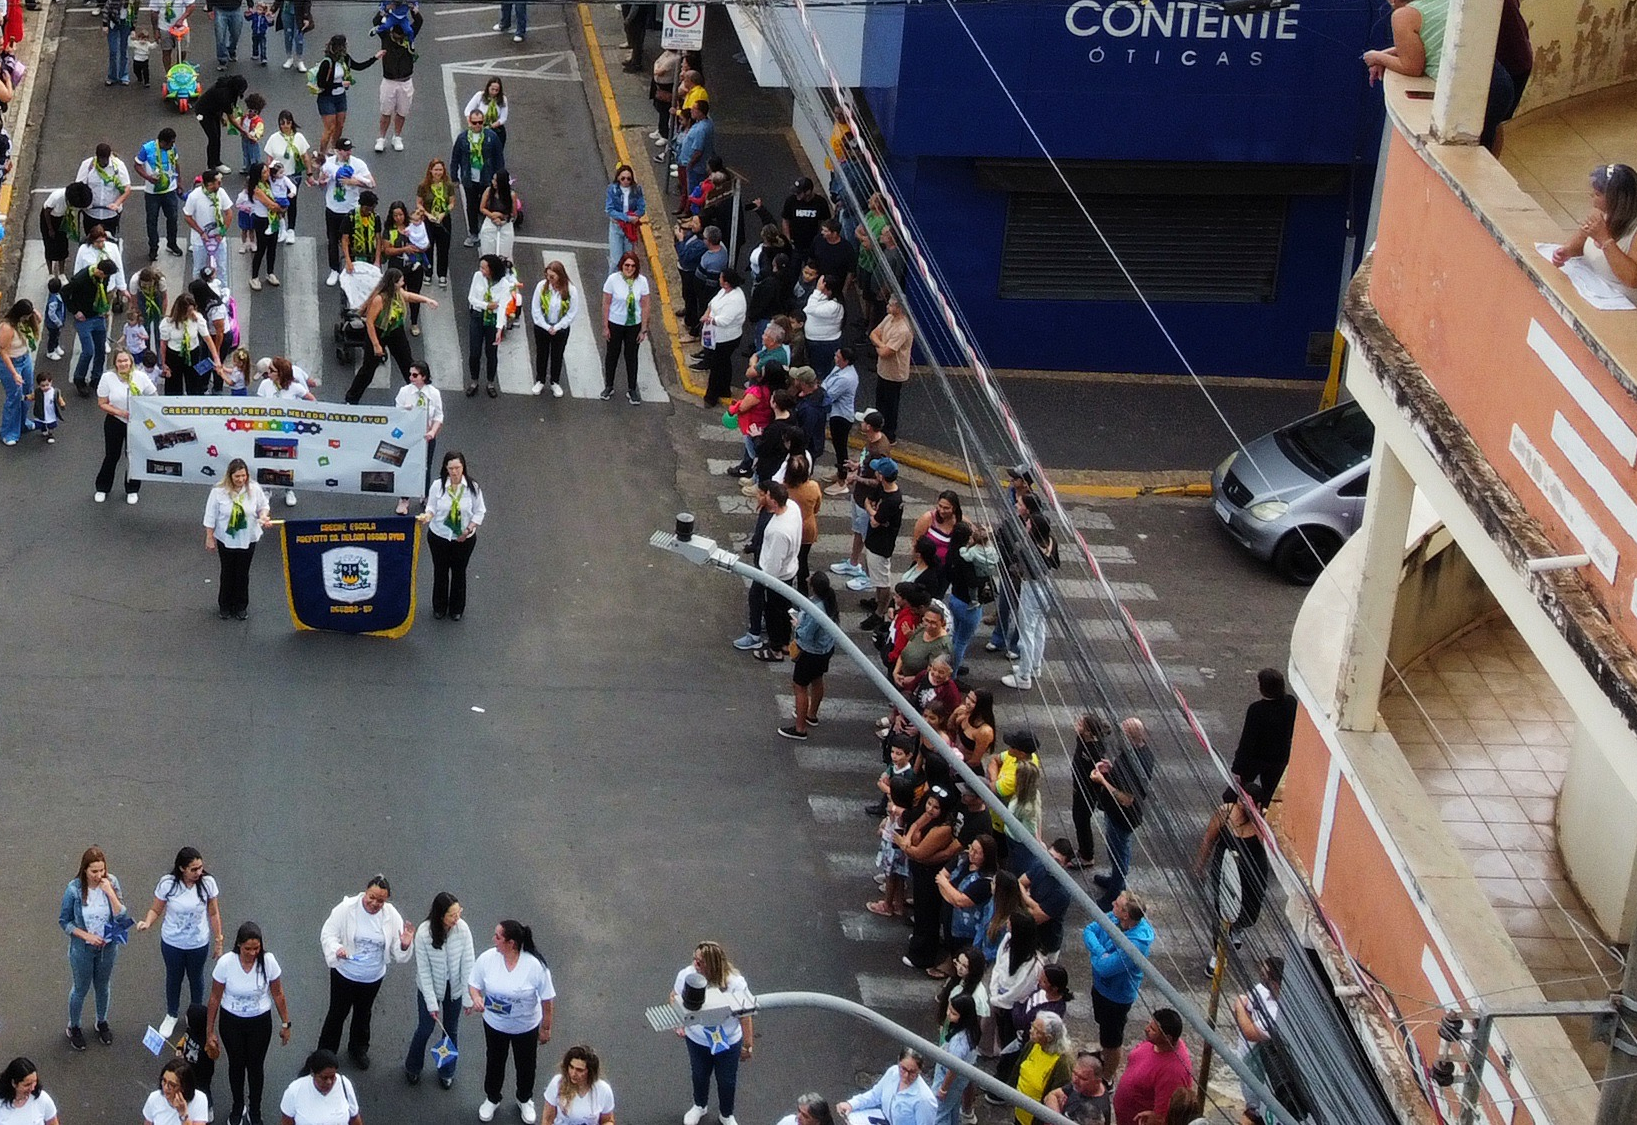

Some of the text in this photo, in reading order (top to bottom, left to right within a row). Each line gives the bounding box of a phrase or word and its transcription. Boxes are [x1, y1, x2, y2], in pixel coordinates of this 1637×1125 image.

[678, 4, 691, 21] E
[1088, 46, 1262, 65] ÓTICAS
[162, 406, 201, 415] CRECHE
[202, 406, 240, 416] ESCOLA
[287, 408, 326, 420] NELSON
